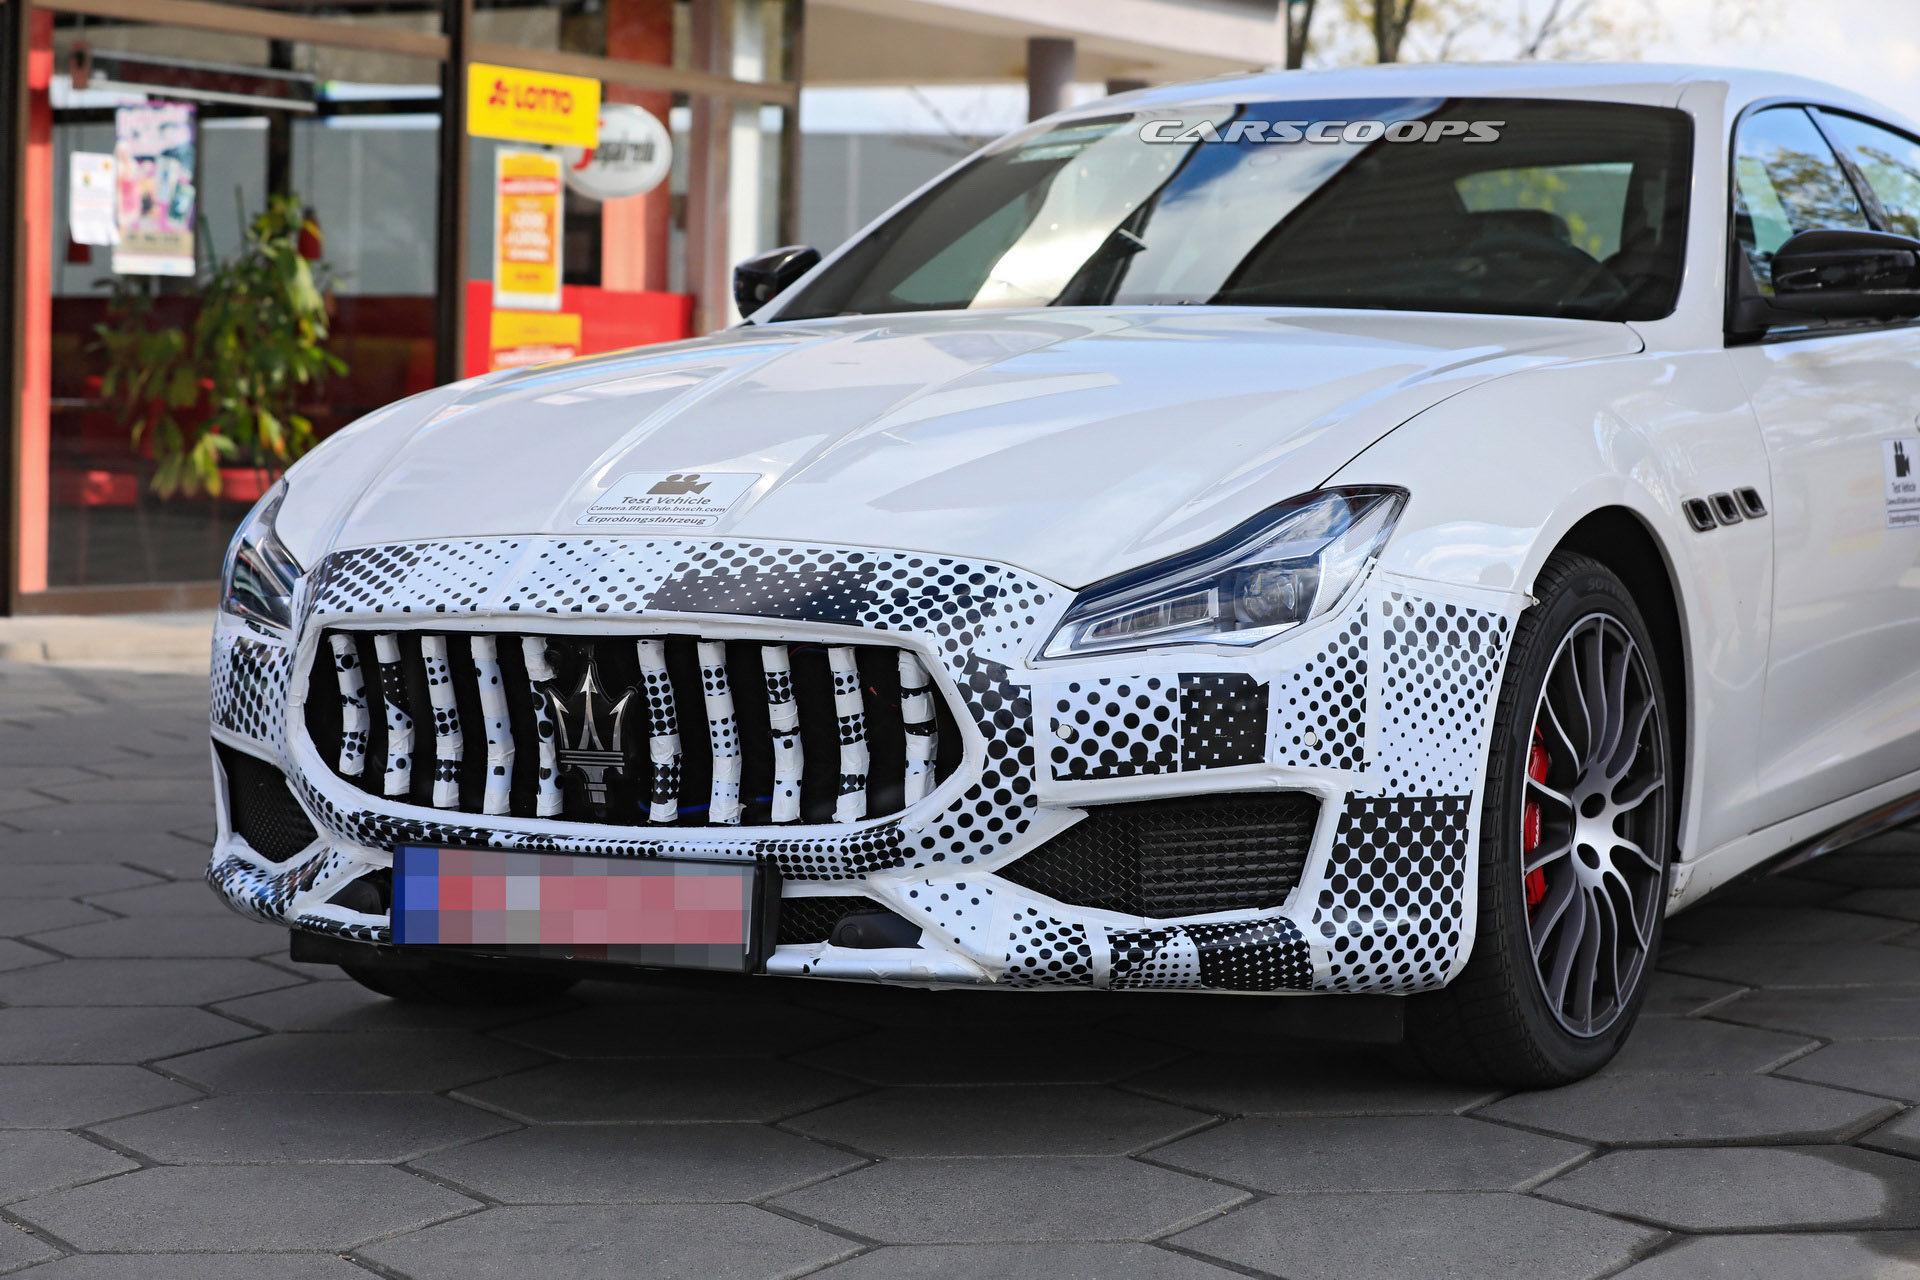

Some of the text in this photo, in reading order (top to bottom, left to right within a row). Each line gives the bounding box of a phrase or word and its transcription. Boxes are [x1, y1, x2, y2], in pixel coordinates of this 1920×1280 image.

[514, 82, 573, 115] LOTTO
[622, 496, 711, 505] Test Vehicle
[590, 505, 726, 513] Camera.BEG@de.bosch.com
[587, 516, 706, 525] Erprobungsfahrzeug
